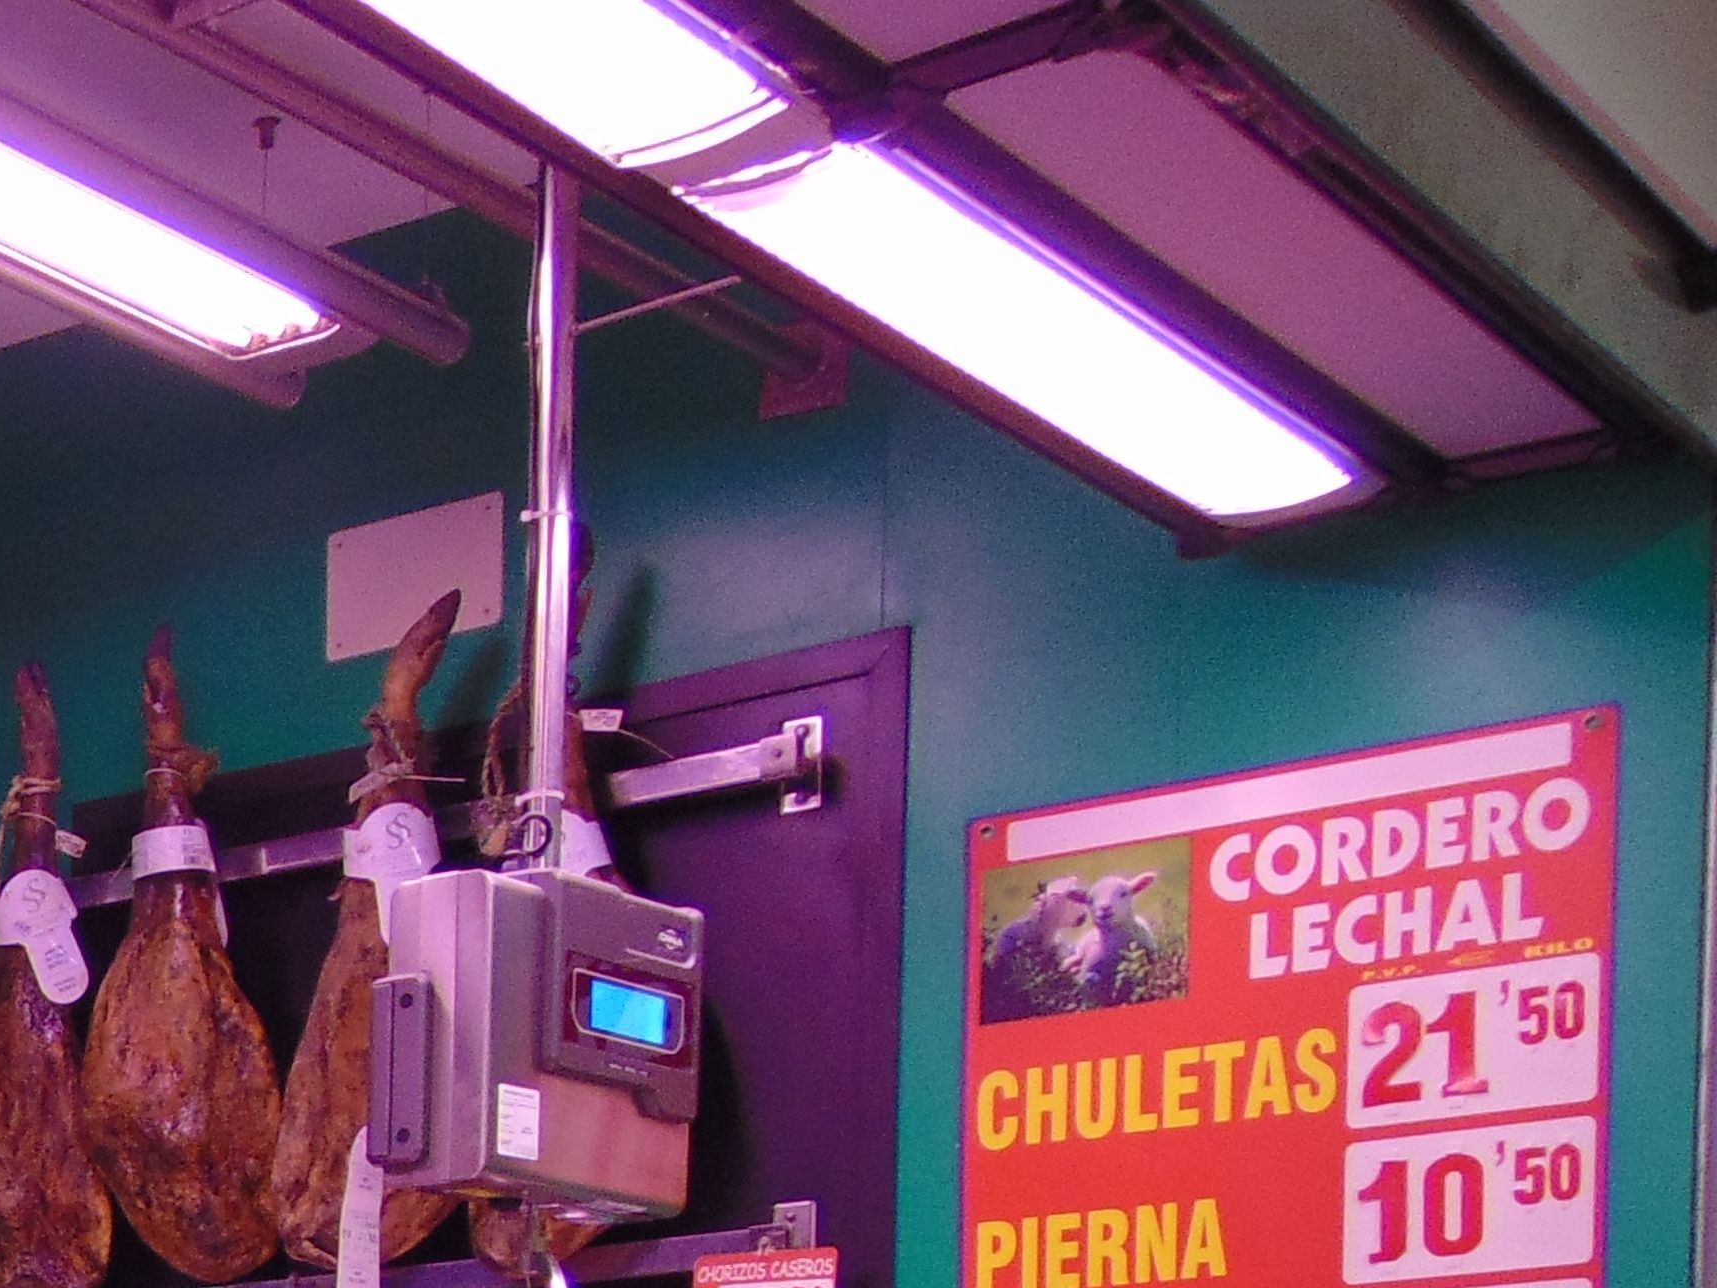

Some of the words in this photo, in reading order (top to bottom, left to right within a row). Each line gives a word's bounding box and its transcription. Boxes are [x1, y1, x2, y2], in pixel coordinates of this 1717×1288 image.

[1208, 776, 1592, 902] CORDERO
[1248, 870, 1545, 981] LECHAL
[1523, 937, 1595, 959] KILO
[976, 1026, 1339, 1151] CHULETAS
[696, 1263, 767, 1284] CHORIZOS
[770, 1258, 835, 1277] CASEROS
